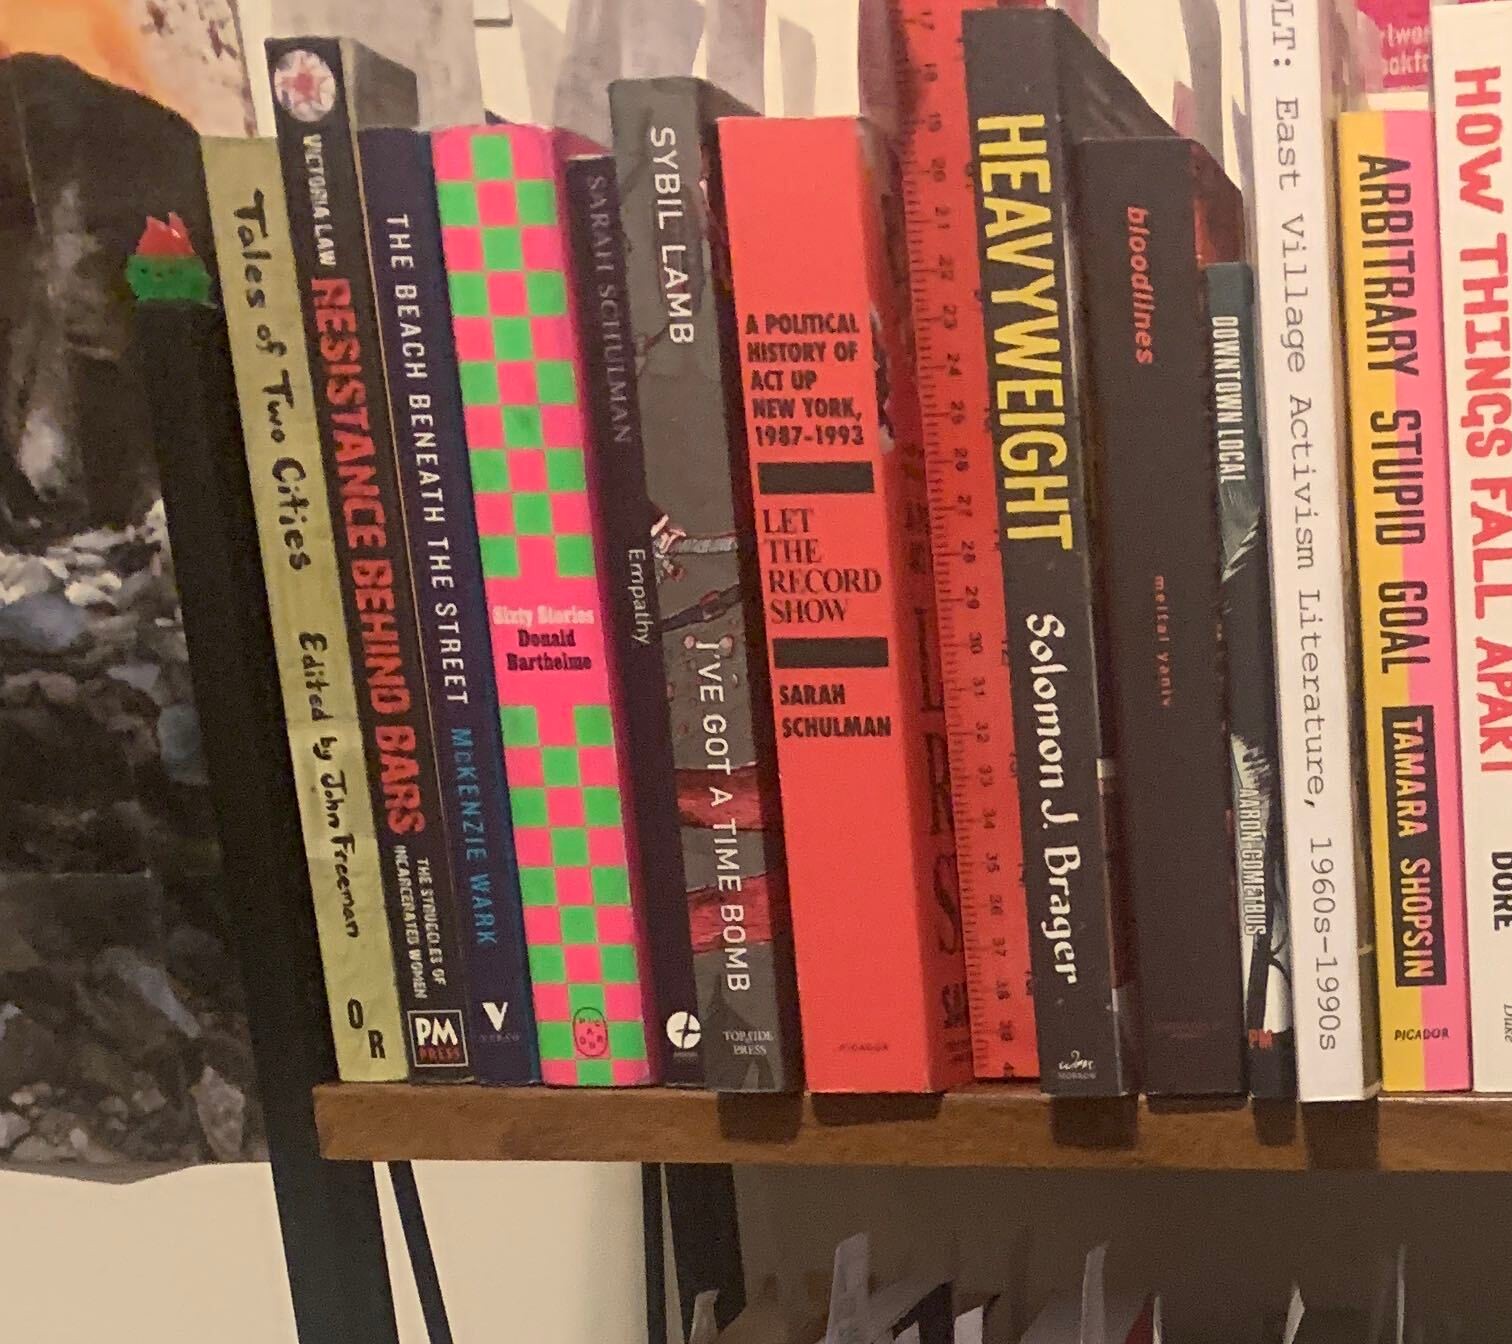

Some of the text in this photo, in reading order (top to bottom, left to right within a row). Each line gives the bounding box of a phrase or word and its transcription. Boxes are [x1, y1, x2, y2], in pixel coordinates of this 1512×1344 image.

[1454, 65, 1506, 214] HOW
[650, 125, 695, 345] SYBIL LAMB
[1127, 204, 1156, 365] bloodlines
[234, 188, 312, 572] Tales of Two Cities
[745, 312, 860, 335] A POLITICAL
[747, 340, 858, 363] HISTORY OF
[750, 369, 817, 392] ACT UP
[1211, 315, 1246, 484] DOWNTOWN LOCAL
[386, 213, 469, 704] THE BEACH BENEATH THE STREET
[752, 397, 864, 421] NEW YORK,
[755, 425, 865, 446] 1987-1993
[311, 277, 425, 836] RESISTANCE BEHIND BARS
[977, 112, 1083, 987] HEAVYWEIGHT Solomon J. Brager
[1276, 97, 1344, 1052] East Village Activism Literature, 1960s-1990s
[1357, 153, 1434, 980] ARBITRARY STUPID GOAL TAMARA SHOPSIN
[696, 640, 751, 993] I'VE GOT A TIME BOMB
[1394, 1027, 1450, 1041] PICADOR
